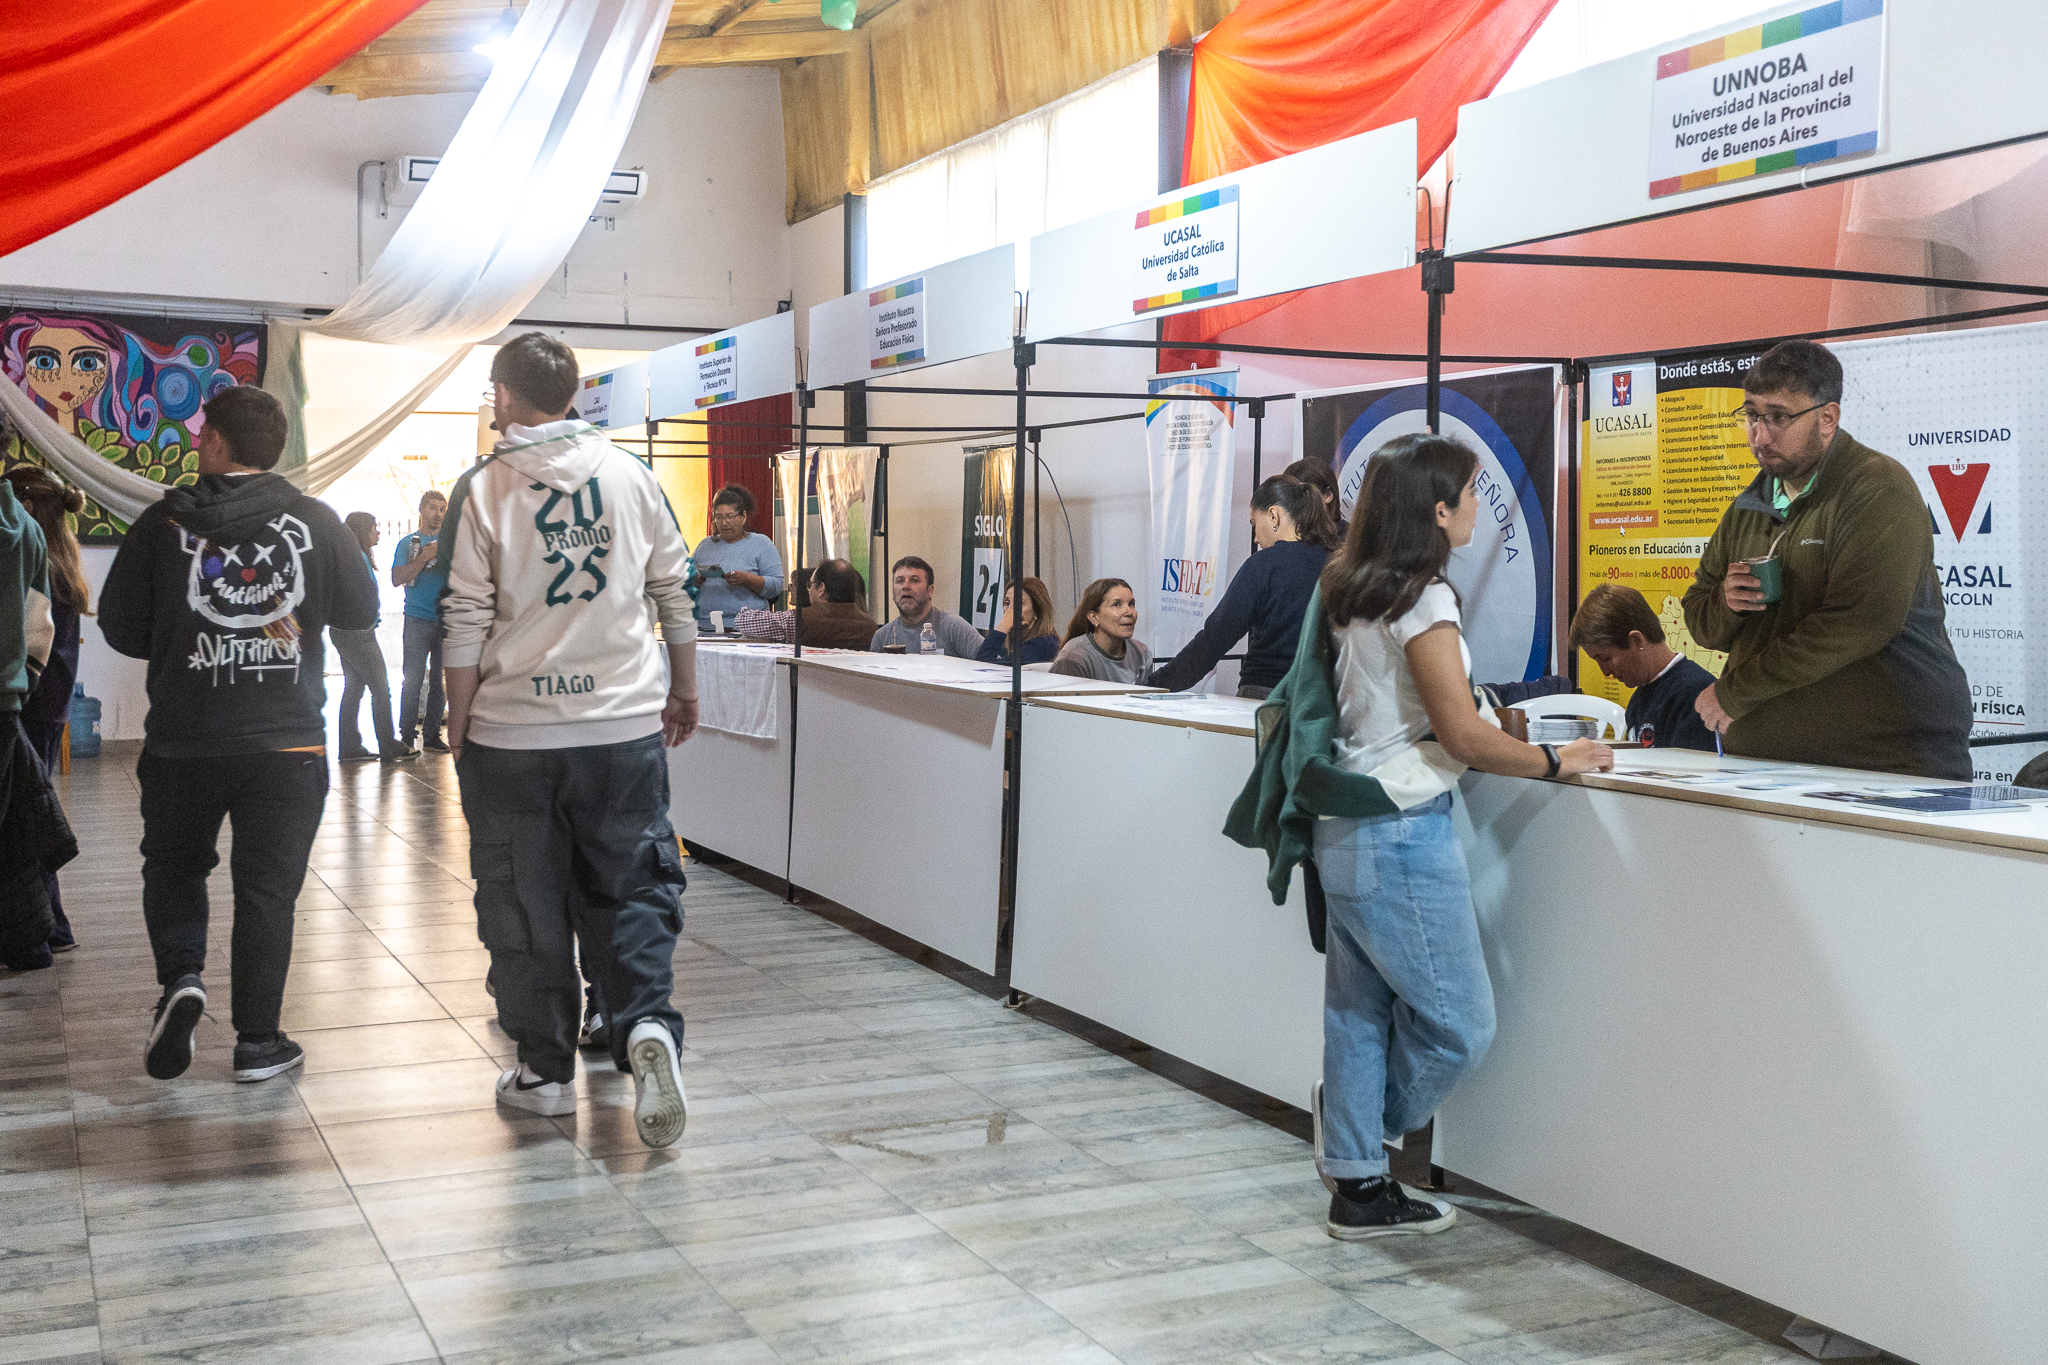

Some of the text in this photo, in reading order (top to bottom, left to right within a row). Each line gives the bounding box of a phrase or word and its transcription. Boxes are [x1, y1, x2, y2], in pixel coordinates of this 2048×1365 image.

[1713, 52, 1808, 96] UNNOBA
[1672, 66, 1853, 128] Universidad Nacional del
[1675, 92, 1851, 148] Noroeste de la Provincia
[1702, 124, 1818, 163] de Buenos Aires
[1164, 224, 1201, 246] UCASAL
[1143, 240, 1224, 270] Universidad Católica
[1167, 264, 1199, 281] de Salta
[879, 307, 914, 322] Instituto Nuestra
[876, 318, 917, 337] Señora Profesorado
[880, 336, 901, 349] Educación
[1660, 362, 1697, 379] Donde
[1701, 358, 1734, 374] estás,
[1596, 413, 1652, 433] UCASAL
[1665, 415, 1691, 423] Licenciatura
[1665, 425, 1691, 433] Licenciatura
[1908, 428, 2011, 446] UNIVERSIDAD
[1619, 488, 1631, 496] 426
[1633, 487, 1651, 496] 8800
[529, 477, 603, 534] 20
[975, 515, 1004, 536] SIGLO
[1595, 515, 1653, 524] www.ucasal.edu.ar
[543, 525, 612, 552] PROMO
[1589, 545, 1626, 555] Pioneros
[1629, 546, 1640, 554] en
[1644, 542, 1692, 554] Educación
[1695, 545, 1700, 553] a
[542, 545, 609, 607] 25
[1608, 567, 1619, 579] 90
[1662, 566, 1689, 579] 8.000
[976, 552, 1002, 630] 21
[1956, 628, 1969, 638] TU
[1974, 629, 2024, 640] HISTORIA
[531, 674, 595, 696] TIAGO
[1986, 685, 2003, 697] DE
[1981, 700, 2025, 716] FÍSICA
[1996, 771, 2012, 782] en
